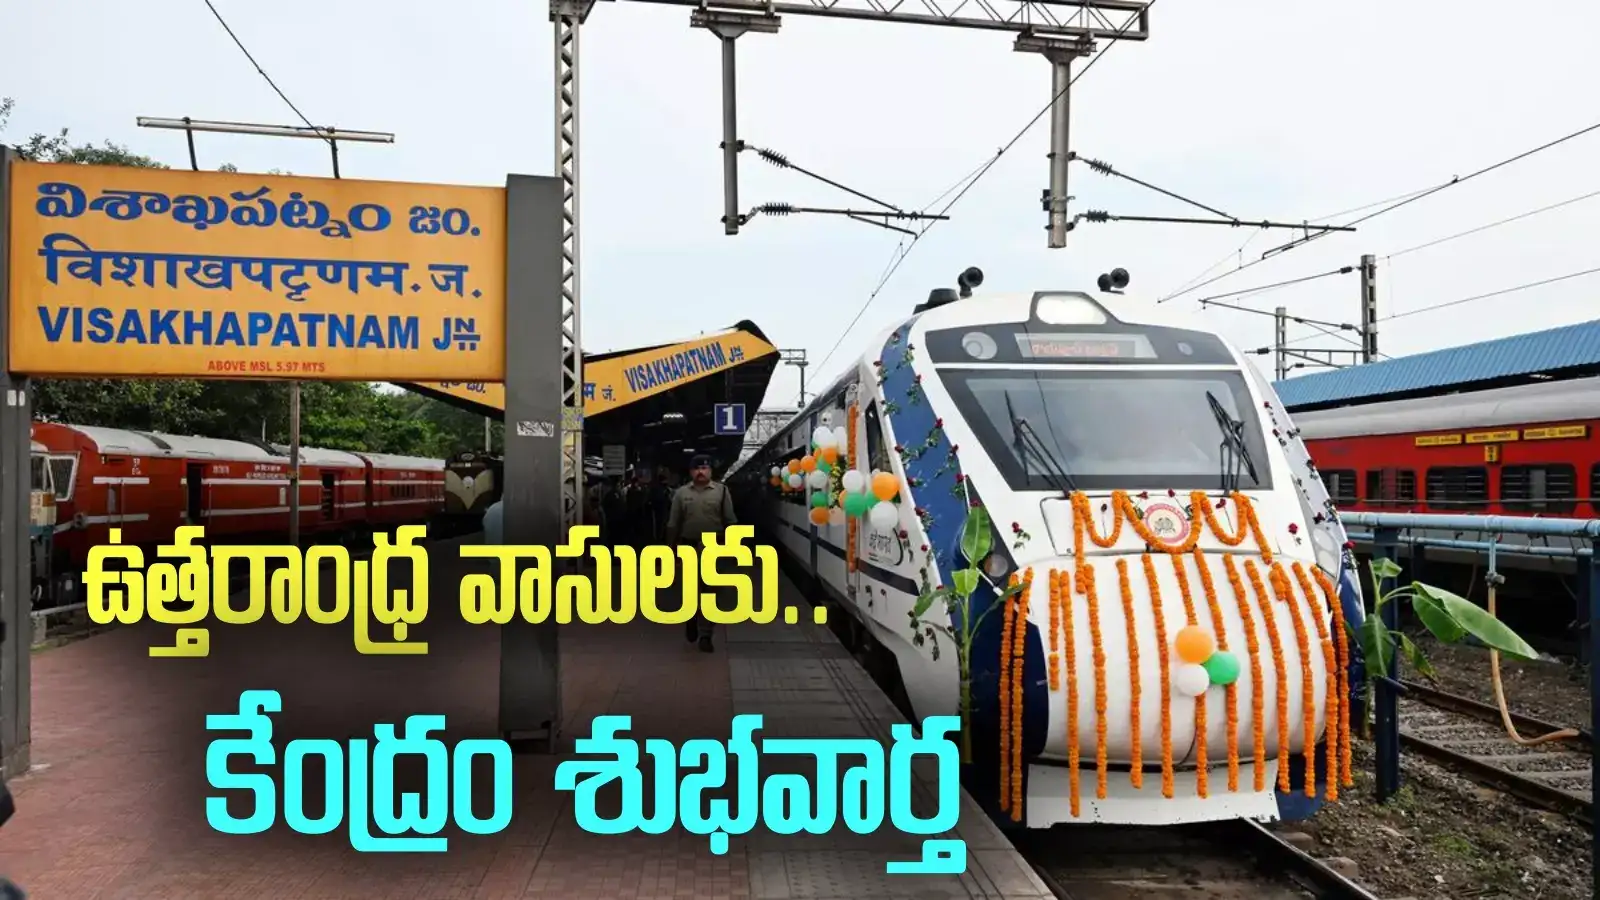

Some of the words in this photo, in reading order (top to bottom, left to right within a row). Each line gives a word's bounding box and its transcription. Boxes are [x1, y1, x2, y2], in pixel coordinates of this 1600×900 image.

[36, 182, 392, 239] విశాఖపట్నం
[37, 306, 419, 350] VISAKHAPATNAM
[207, 360, 246, 371] ABOVE
[250, 361, 273, 372] MSL
[276, 362, 299, 372] 5.97
[302, 362, 325, 373] MTS
[624, 341, 727, 393] VISAKHAPATNAM
[721, 406, 738, 430] 1
